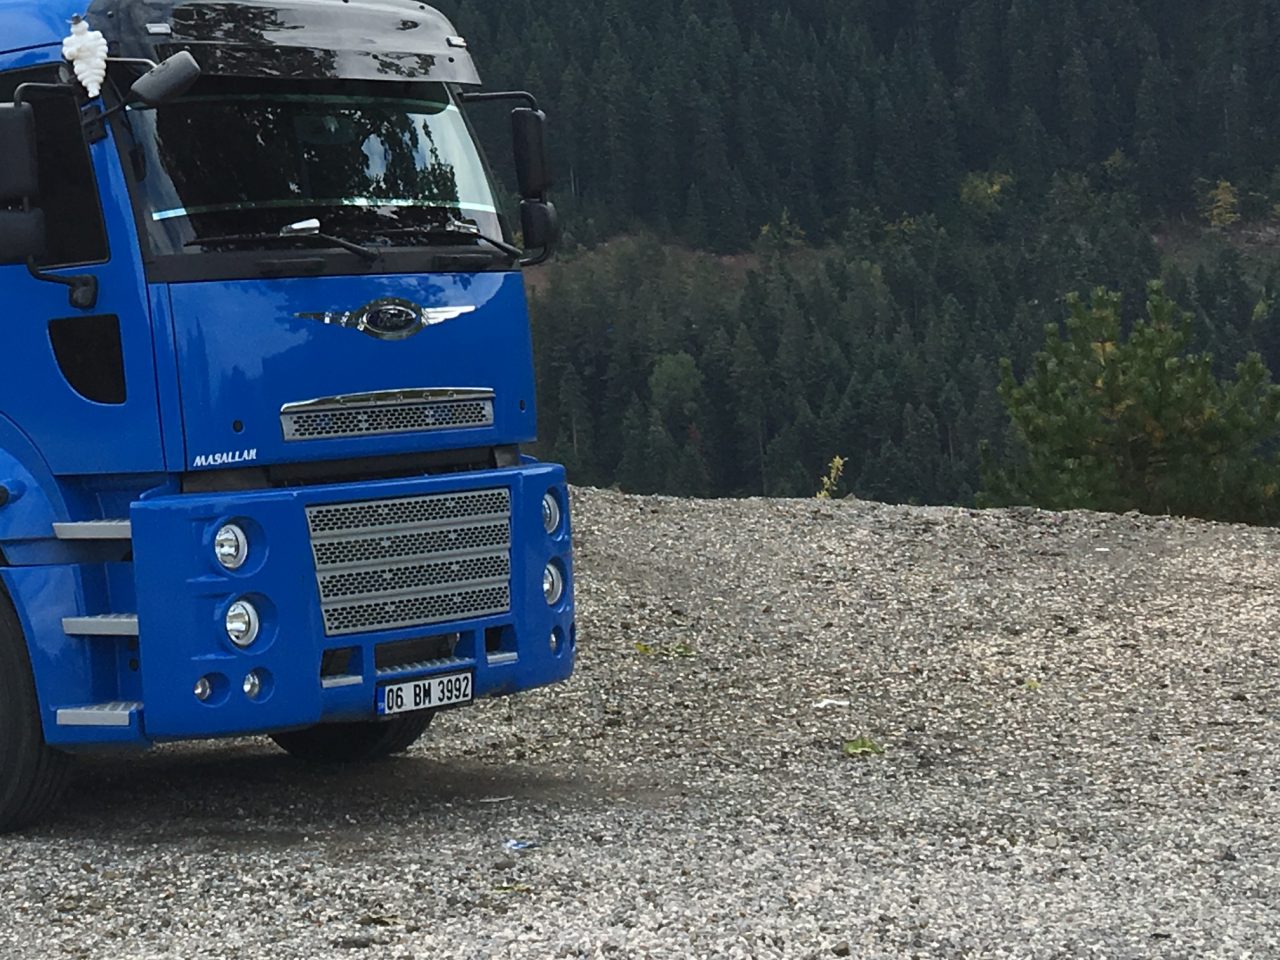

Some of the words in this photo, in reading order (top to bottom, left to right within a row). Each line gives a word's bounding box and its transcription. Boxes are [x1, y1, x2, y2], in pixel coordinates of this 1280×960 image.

[387, 686, 404, 711] 06
[413, 681, 432, 707] BM
[438, 676, 470, 702] 3992
